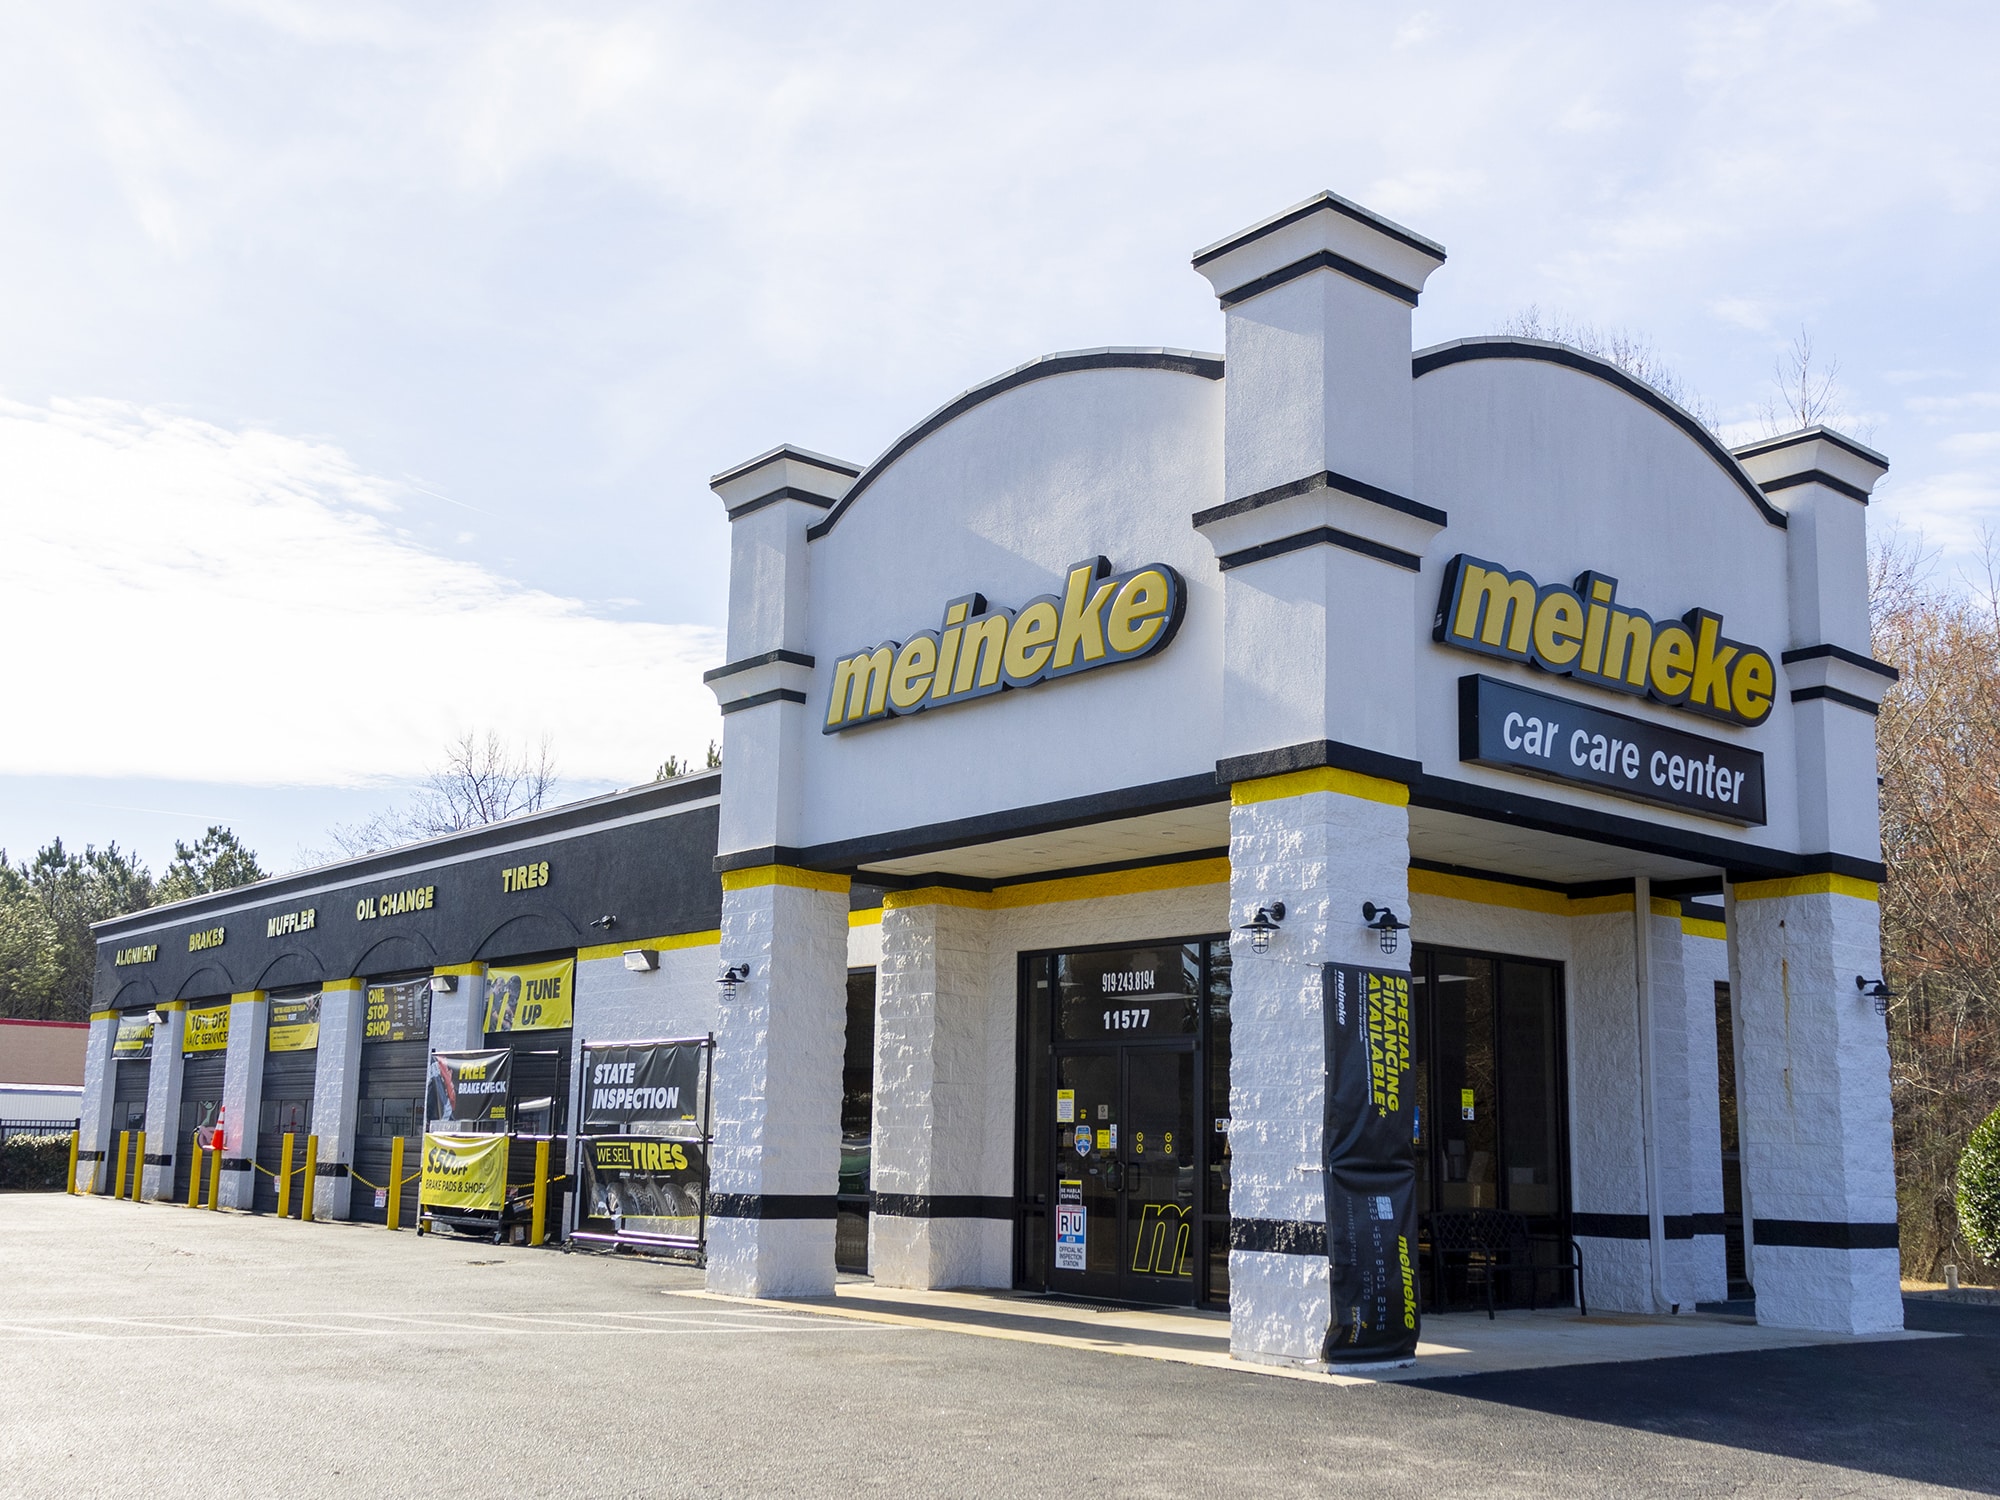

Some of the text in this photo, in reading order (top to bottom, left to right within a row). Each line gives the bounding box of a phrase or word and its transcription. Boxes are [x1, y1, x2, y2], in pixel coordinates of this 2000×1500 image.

[827, 565, 1168, 725] meineke
[1453, 565, 1774, 719] meineke
[1503, 712, 1745, 804] car care center
[502, 861, 549, 892] TIRES
[357, 886, 434, 920] OIL CHANGE
[267, 908, 315, 937] MUFFLER
[189, 927, 225, 952] BRAKES
[115, 944, 158, 966] ALIGNMENT
[368, 988, 385, 1004] ONE
[526, 977, 561, 1001] TUNE
[1338, 970, 1347, 1026] meineke
[212, 1011, 228, 1028] OFF
[367, 1004, 389, 1020] STOP
[521, 1004, 542, 1026] UP
[1103, 1009, 1150, 1030] 11577
[1396, 976, 1410, 1072] SPECIAL
[366, 1021, 391, 1037] SHOP
[1382, 975, 1399, 1112] FINANCING
[459, 1062, 487, 1080] FREE
[593, 1063, 635, 1084] STATE
[458, 1081, 506, 1094] BRAKE CHECK
[592, 1087, 679, 1109] INSPECTION
[427, 1147, 468, 1176] $50 OFF
[596, 1142, 688, 1170] WE SELL TIRES
[425, 1179, 486, 1194] BRAKE PADS & SHOES
[1061, 1215, 1081, 1232] R U
[1059, 1253, 1082, 1261] INSPECTION
[1397, 1235, 1417, 1329] meineke
[1376, 1296, 1386, 1331] 2345
